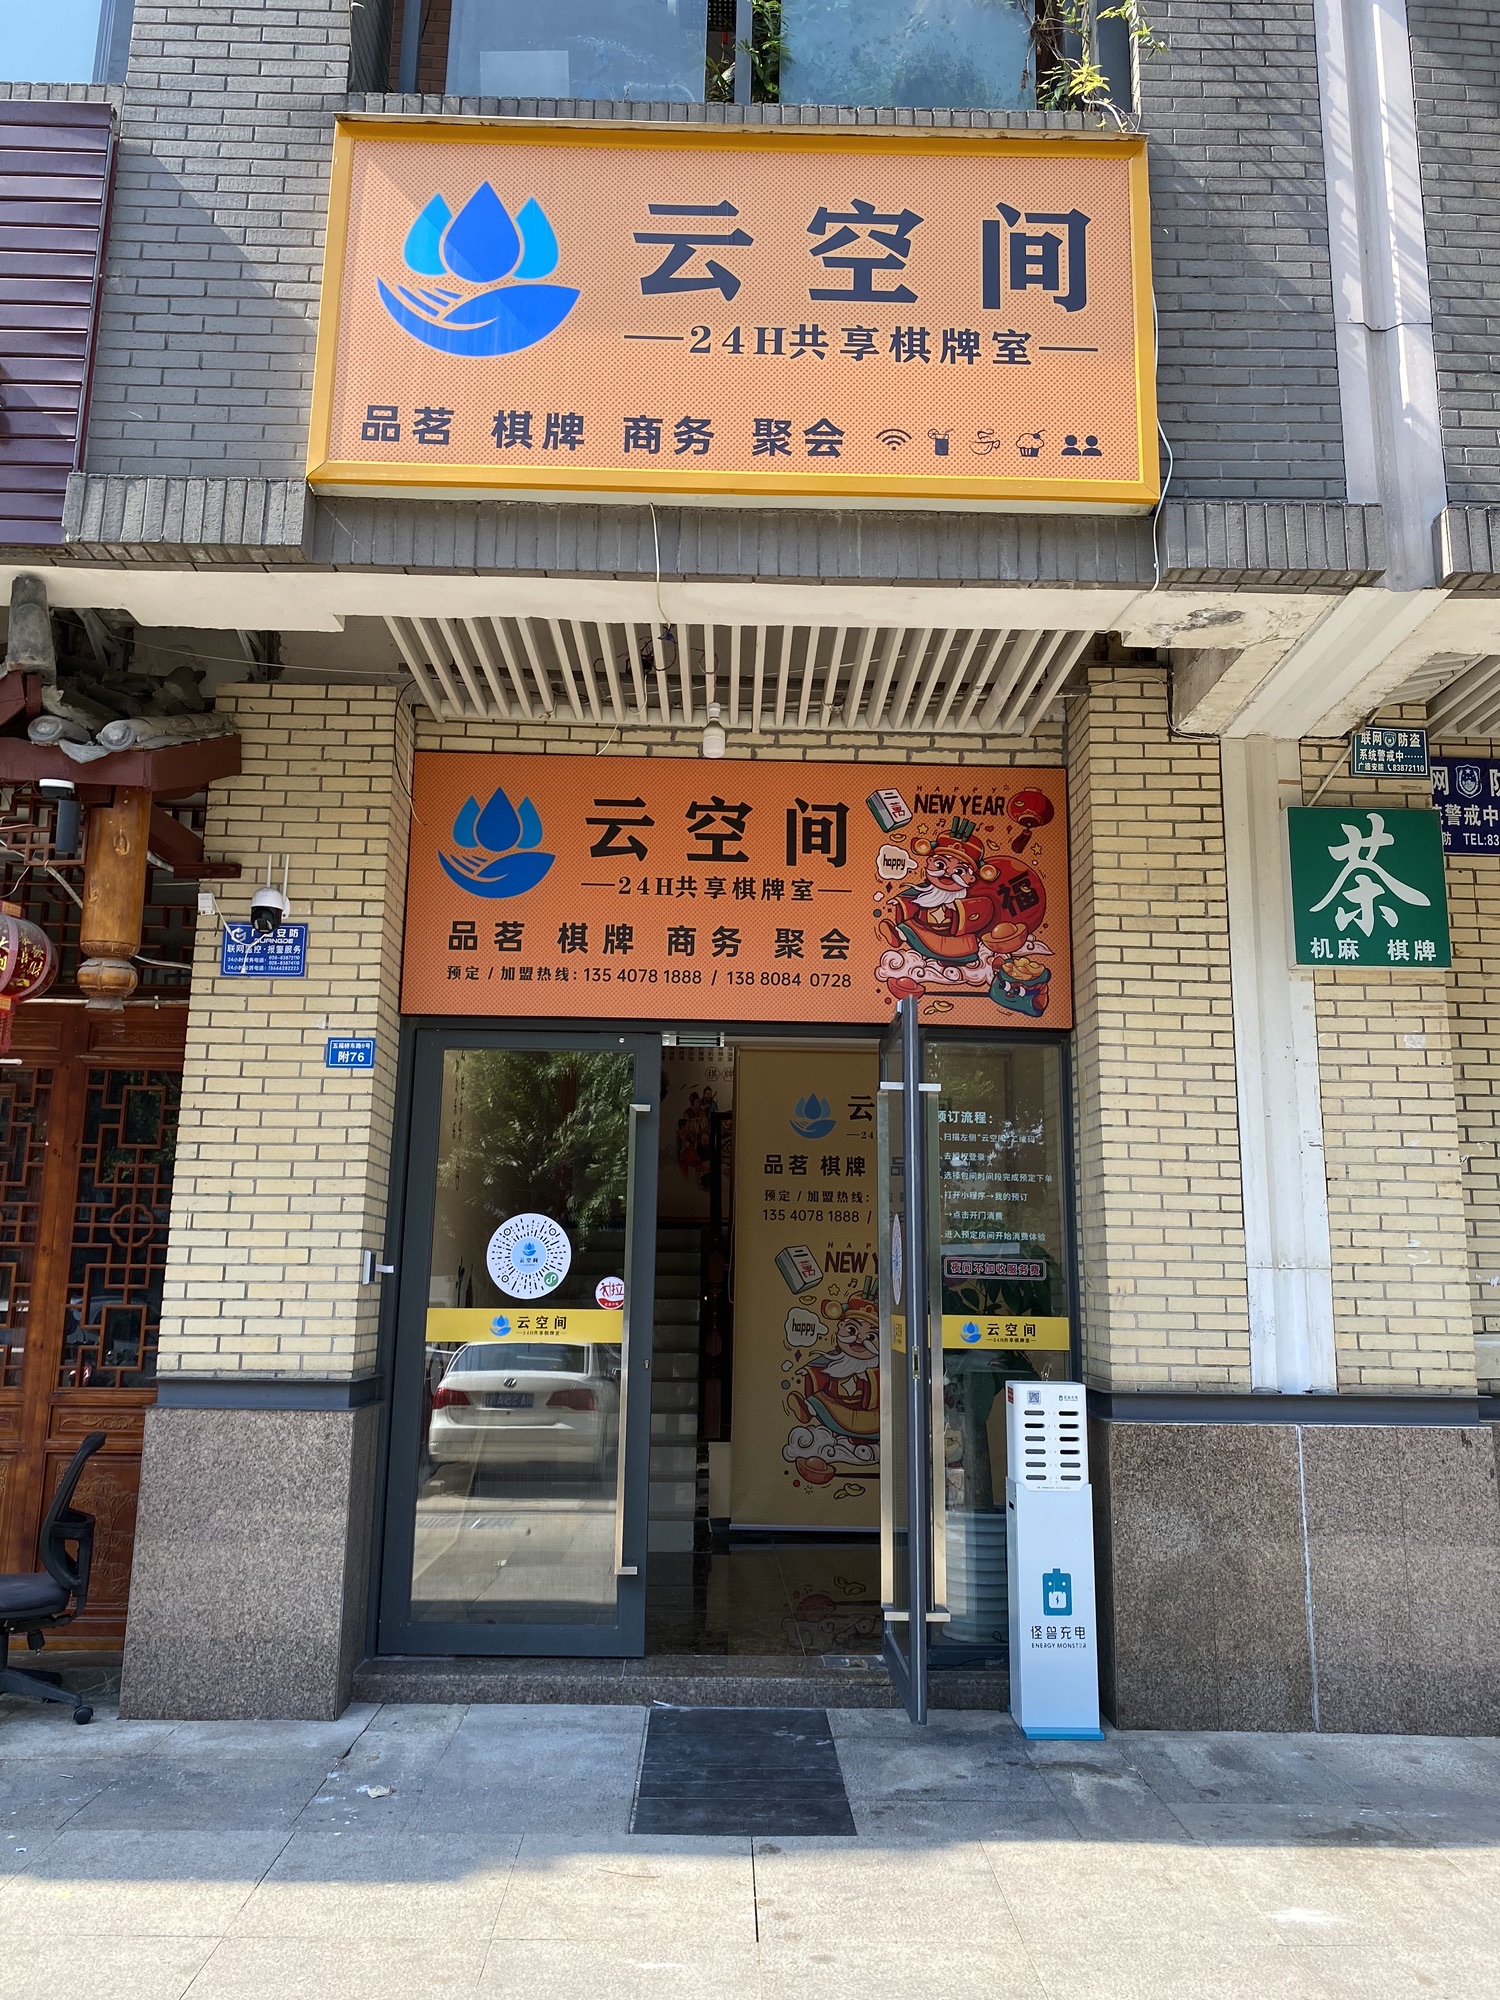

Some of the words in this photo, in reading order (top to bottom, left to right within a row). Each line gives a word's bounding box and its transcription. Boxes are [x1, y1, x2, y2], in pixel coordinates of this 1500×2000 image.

[632, 197, 1091, 315] 云空间
[689, 323, 1032, 367] 24H共享棋牌室
[360, 404, 455, 447] 品茗
[491, 409, 585, 451] 棋牌
[622, 414, 715, 456] 商务
[752, 417, 845, 459] 聚会
[1360, 730, 1382, 746] 联网
[1397, 732, 1421, 748] 防盗
[1392, 764, 1425, 773] 83872110
[916, 786, 997, 794] HAPPY
[1430, 766, 1450, 796] 网
[914, 793, 957, 814] NEW
[960, 795, 1006, 816] YEAR
[585, 794, 851, 868] 云空间
[882, 853, 906, 870] happy
[1309, 812, 1431, 937] 茶
[618, 875, 815, 902] 24H共享棋牌室
[997, 871, 1041, 918] 福
[447, 920, 526, 952] 品茗
[557, 923, 635, 956] 棋牌
[666, 925, 743, 959] 商务
[774, 928, 852, 961] 聚会
[1310, 937, 1360, 961] 机麻
[1386, 939, 1437, 962] 棋牌
[446, 966, 480, 981] 预定
[584, 967, 611, 982] 135
[617, 969, 659, 983] 4078
[663, 970, 702, 985] 1888
[727, 970, 755, 985] 138
[760, 971, 802, 986] 8084
[810, 973, 852, 988] 0728
[337, 1051, 365, 1063] 附76
[764, 1154, 809, 1176] 品茗
[820, 1155, 866, 1177] 棋牌
[764, 1189, 791, 1202] 预定
[763, 1209, 786, 1221] 135
[790, 1209, 824, 1222] 4078
[828, 1211, 860, 1223] 1888
[824, 1251, 868, 1273] NEW
[950, 1261, 1041, 1276] 夜间不加收服务费
[516, 1315, 567, 1330] 云空间
[791, 1318, 816, 1337] happy
[986, 1323, 1036, 1338] 云空间
[1031, 1625, 1086, 1640] 怪兽充电
